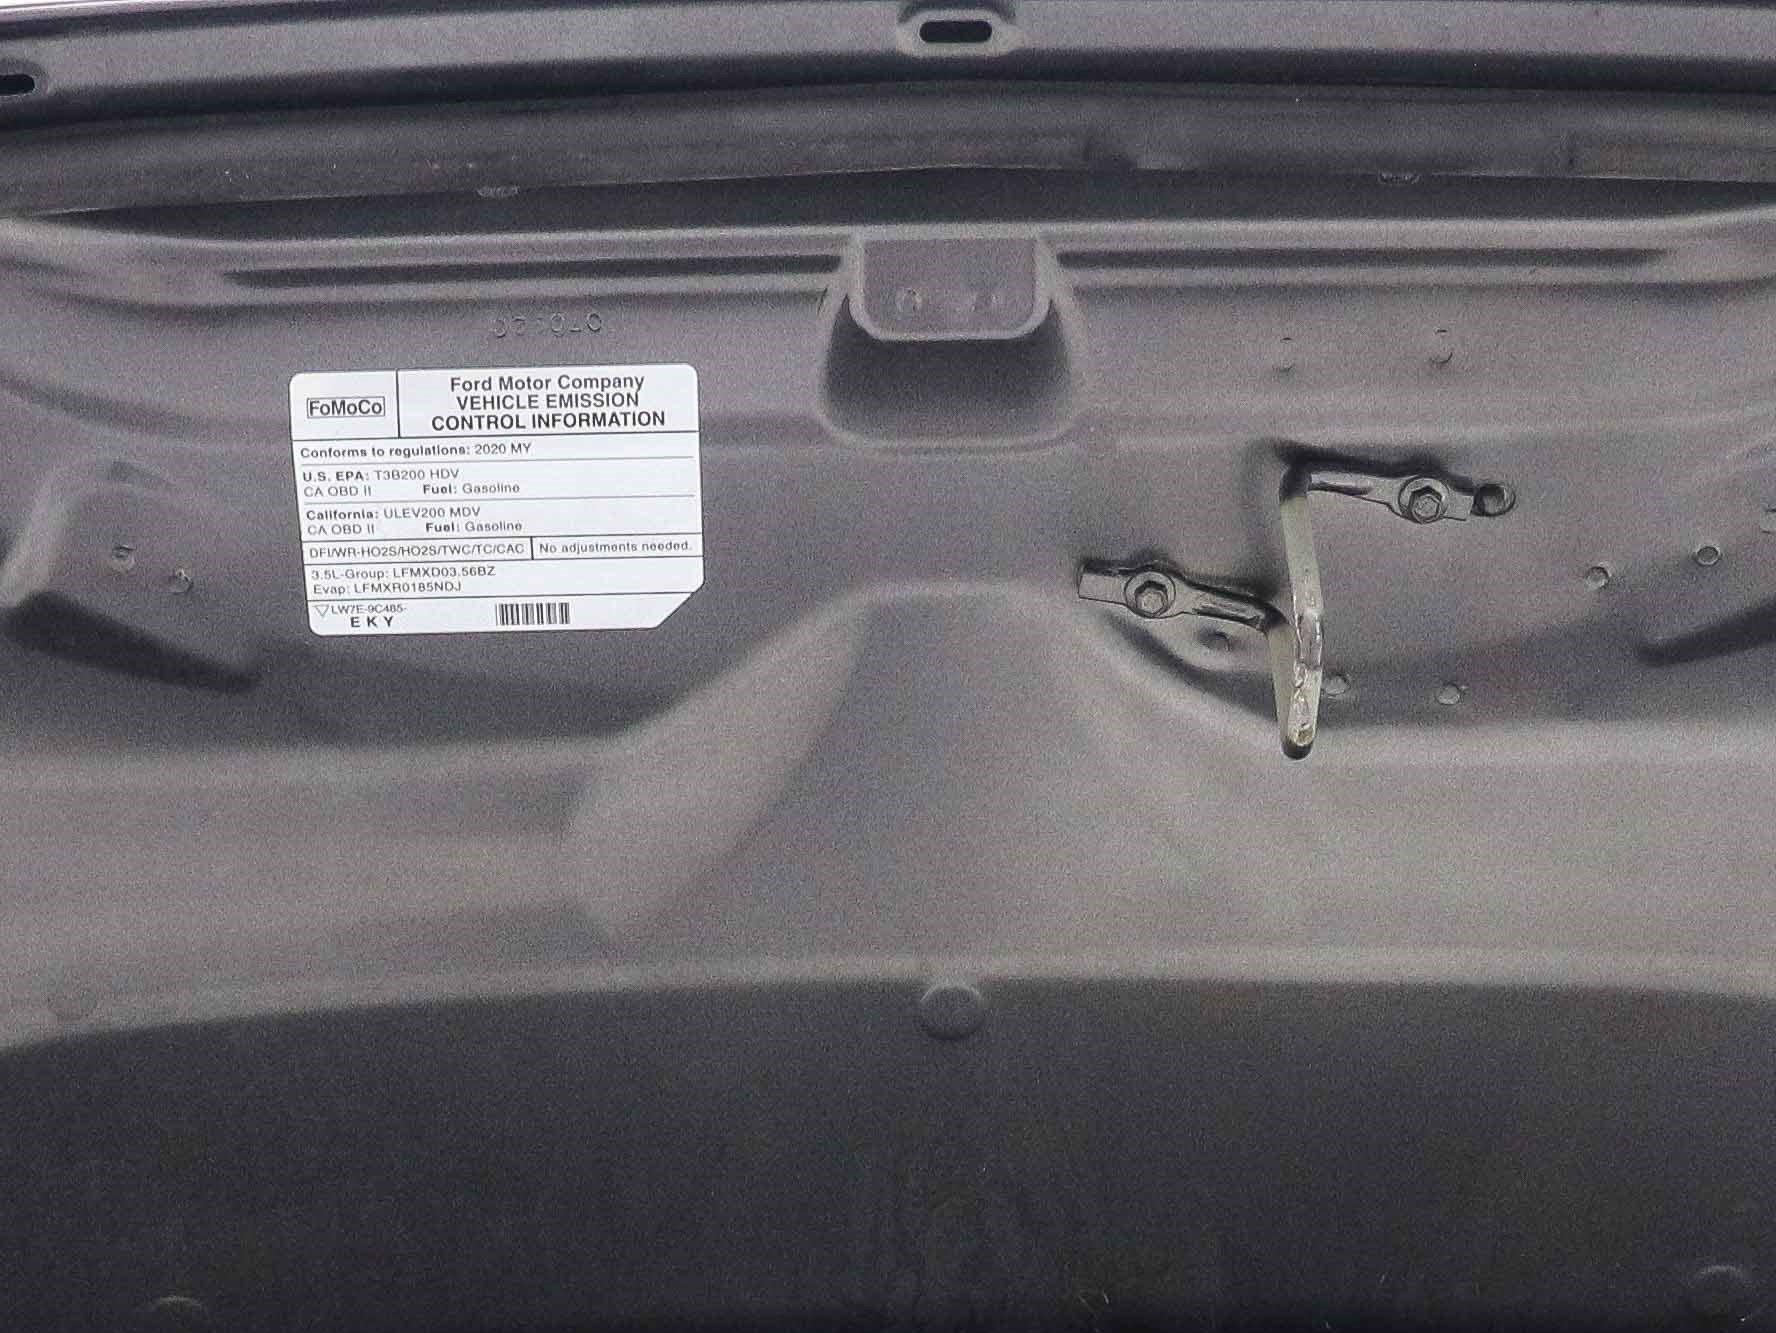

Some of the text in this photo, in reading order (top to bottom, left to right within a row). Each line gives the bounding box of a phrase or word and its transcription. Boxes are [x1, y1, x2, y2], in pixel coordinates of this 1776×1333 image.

[451, 374, 645, 395] Ford Motor Company
[309, 399, 383, 417] FoMoCo
[457, 392, 639, 411] VEHICLE EMISSION
[432, 411, 665, 431] CONTROL INFORMATION
[300, 442, 532, 459] Conforms to regulations: 2020 MY
[303, 469, 459, 482] U.S. EPA: T3B200 HDV
[304, 487, 324, 498] CA
[328, 486, 359, 497] OBD
[423, 484, 457, 495] Fuel:
[462, 483, 520, 494] Gasoline
[306, 507, 481, 520] California: ULEV200 MDV
[307, 524, 327, 535] CA
[331, 523, 362, 535] OBD
[425, 522, 460, 533] Fuel:
[465, 521, 523, 533] Gasoline
[540, 543, 557, 553] No
[562, 541, 638, 555] adjustments
[313, 584, 350, 597] Evap:
